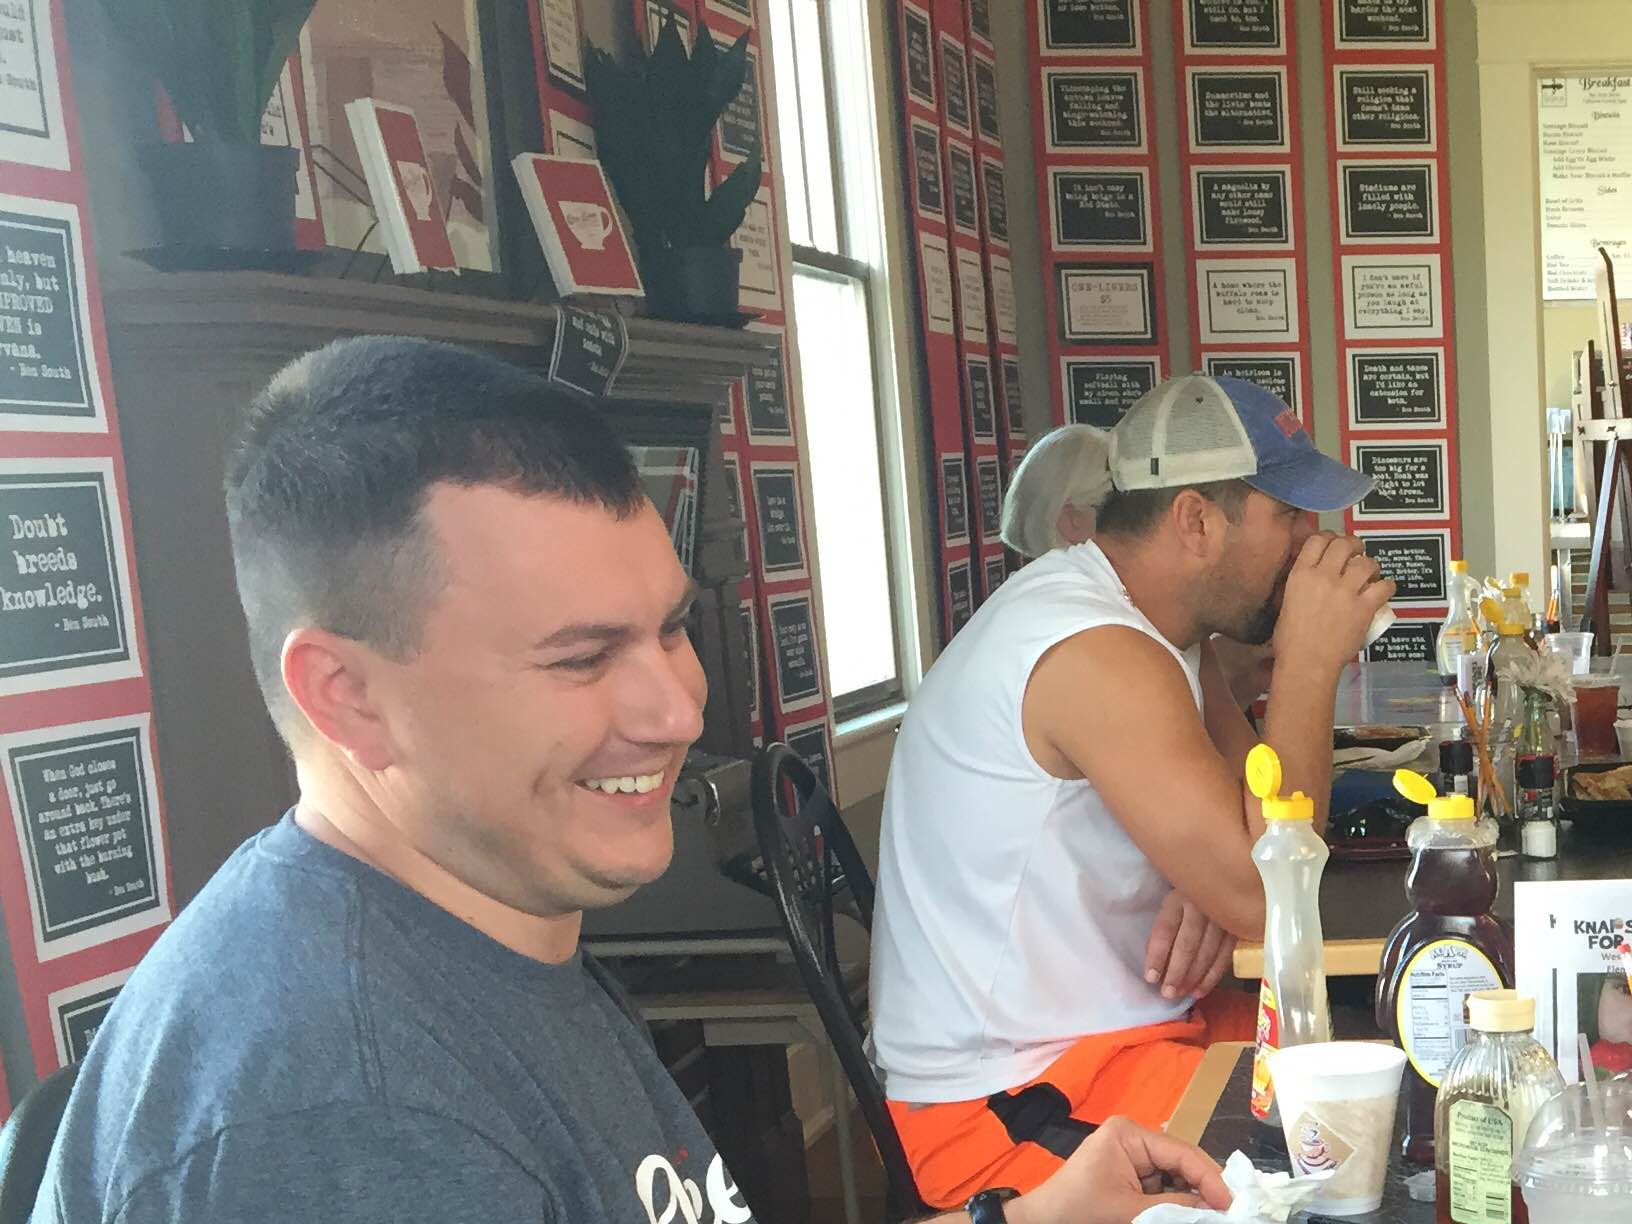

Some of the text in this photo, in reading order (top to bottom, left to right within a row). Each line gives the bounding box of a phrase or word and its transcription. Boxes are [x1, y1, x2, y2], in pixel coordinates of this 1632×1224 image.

[1362, 193, 1390, 201] filled
[1358, 202, 1419, 211] lonely people.
[0, 269, 30, 291] nly,
[0, 292, 54, 314] PROVED
[0, 315, 22, 334] VEN
[41, 364, 72, 379] South
[1380, 373, 1413, 381] certain,
[1416, 372, 1429, 380] but
[1376, 381, 1385, 389] I'd
[1370, 389, 1408, 397] extension
[1387, 397, 1408, 405] both.
[1389, 465, 1402, 473] big
[1405, 464, 1418, 472] for
[1372, 472, 1391, 480] boat.
[1394, 472, 1412, 480] Noah
[1381, 480, 1399, 488] ight
[8, 512, 68, 540] Doubt
[12, 547, 78, 575] breeds
[0, 580, 103, 610] knowledge.
[82, 614, 109, 629] South
[1588, 935, 1624, 950] FOR
[1601, 953, 1623, 961] Wes
